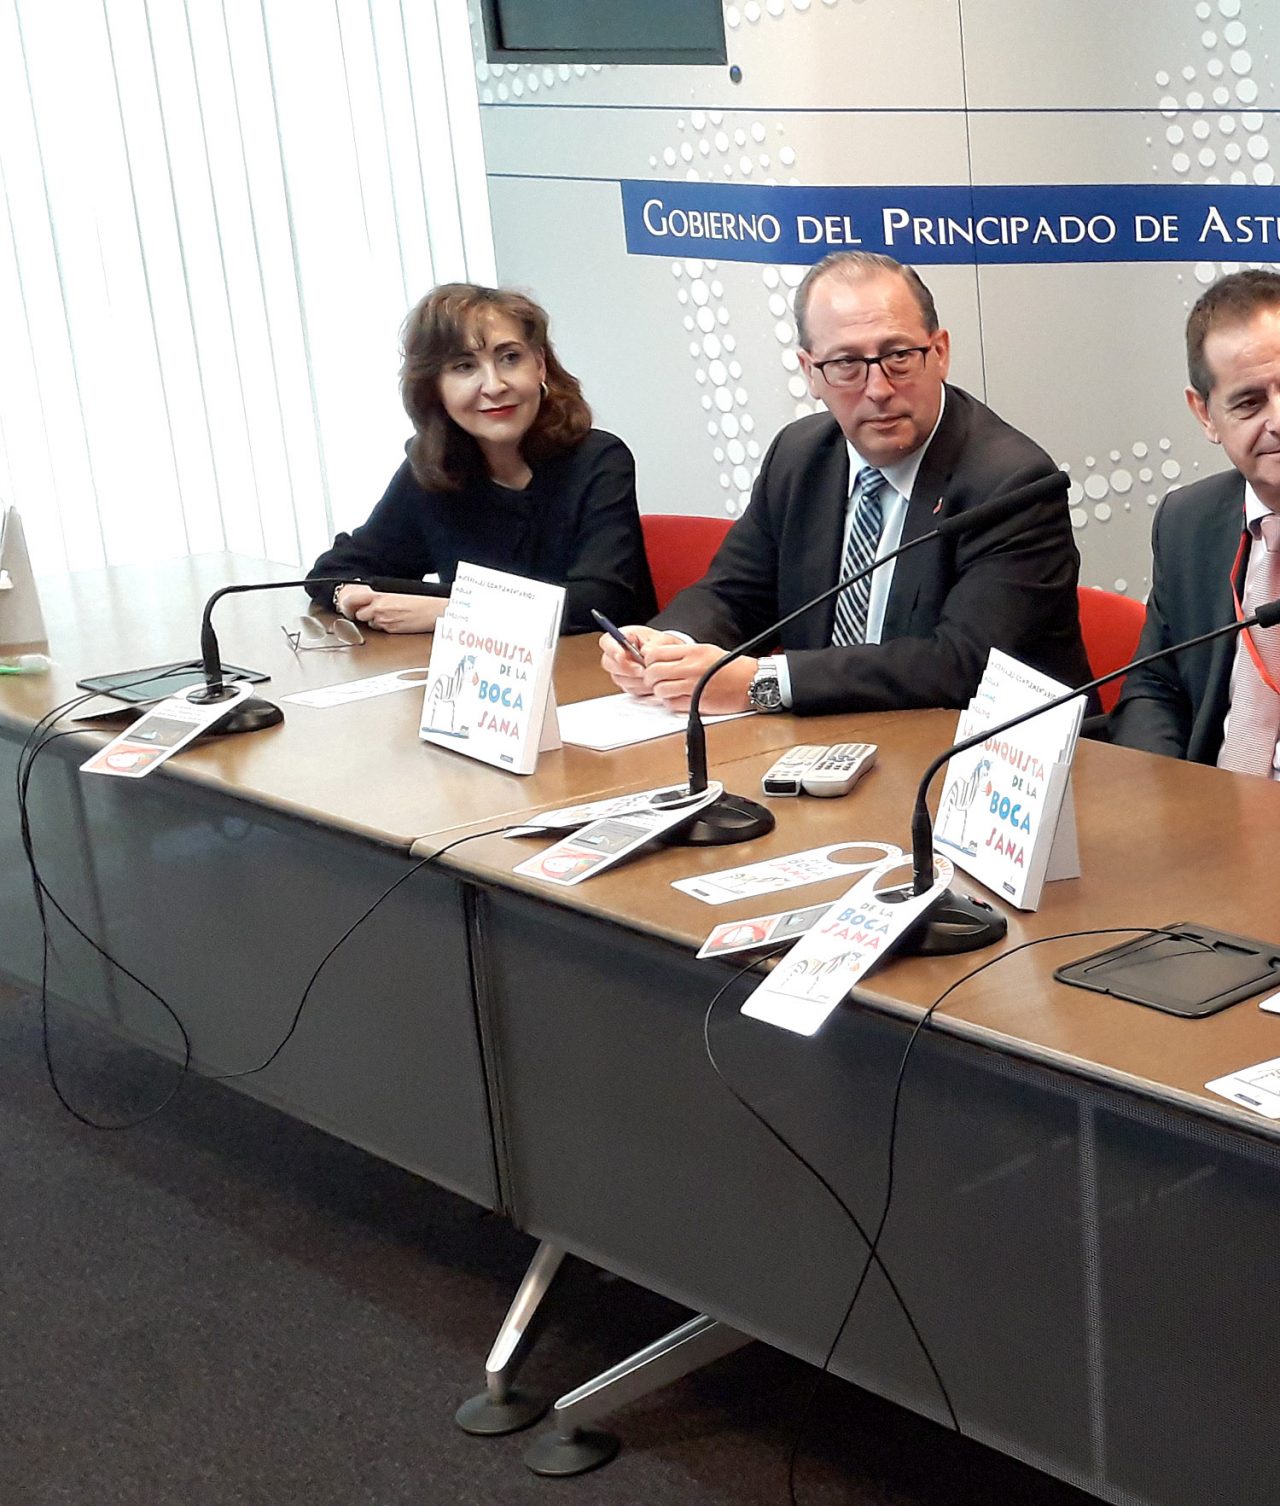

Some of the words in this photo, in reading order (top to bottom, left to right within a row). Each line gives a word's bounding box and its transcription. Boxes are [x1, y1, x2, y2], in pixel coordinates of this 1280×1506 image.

[643, 199, 781, 244] GOBIERNO
[796, 214, 863, 245] DEL
[882, 207, 1117, 246] PRINCIPADO
[1134, 214, 1179, 244] DE
[441, 626, 454, 642] LA
[458, 630, 533, 665] CONQUISTA
[500, 664, 512, 677] DE
[515, 667, 528, 682] LA
[478, 680, 524, 711] BOCA
[477, 711, 520, 740] SANA
[979, 737, 1045, 782] ONQUISTA
[1011, 774, 1024, 792] DE
[1025, 780, 1038, 799] LA
[989, 790, 1032, 835] BOCA
[985, 827, 1025, 868] SANA
[837, 907, 890, 935] BOCA
[859, 901, 877, 913] DE
[821, 923, 880, 950] SANA
